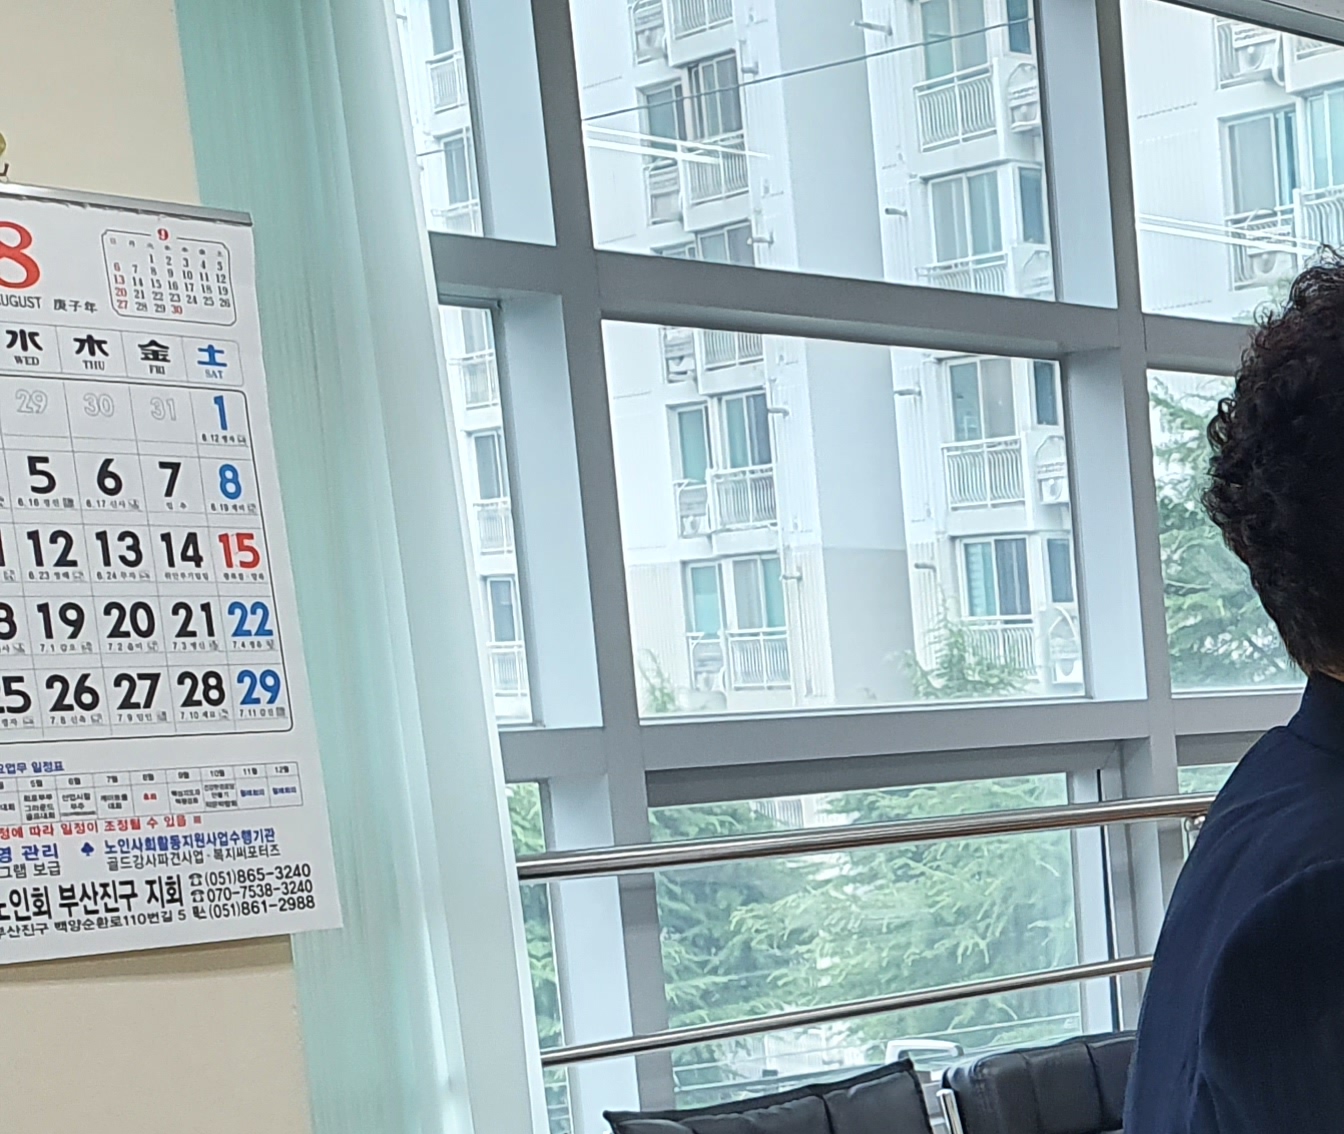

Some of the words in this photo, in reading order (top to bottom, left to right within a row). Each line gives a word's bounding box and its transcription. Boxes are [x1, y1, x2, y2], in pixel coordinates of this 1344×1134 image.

[157, 228, 169, 241] 9
[0, 221, 41, 289] 8
[149, 254, 154, 264] 1
[166, 256, 172, 266] 2
[183, 257, 189, 268] 3
[201, 260, 206, 269] 4
[217, 261, 223, 271] 5
[114, 262, 121, 272] 6
[132, 264, 138, 274] 7
[150, 267, 157, 276] 8
[167, 268, 173, 278] 9
[182, 270, 193, 280] 10
[200, 272, 209, 282] 11
[216, 273, 226, 284] 12
[114, 274, 125, 285] 13
[132, 276, 143, 287] 14
[151, 278, 162, 288] 15
[168, 280, 178, 291] 16
[185, 282, 194, 292] 17
[201, 284, 212, 294] 18
[218, 285, 228, 296] 19
[0, 294, 41, 309] UGUST
[54, 299, 97, 313] 庚子年
[115, 287, 127, 297] 20
[134, 289, 145, 300] 21
[152, 291, 163, 301] 22
[169, 293, 181, 303] 23
[186, 294, 197, 305] 24
[203, 296, 214, 307] 25
[219, 297, 231, 308] 26
[117, 299, 128, 310] 27
[135, 301, 147, 312] 28
[154, 303, 166, 314] 29
[171, 304, 183, 315] 30
[5, 329, 43, 352] 水
[73, 334, 109, 357] 木
[138, 340, 171, 363] 金
[197, 344, 228, 367] 土
[14, 356, 40, 366] WED
[82, 360, 105, 371] THU
[149, 365, 166, 375] FRI
[205, 369, 224, 379] SAT
[15, 389, 48, 414] 29
[83, 393, 115, 417] 30
[151, 397, 177, 421] 31
[213, 395, 228, 430] 1
[27, 456, 56, 494] 5
[97, 458, 123, 496] 6
[158, 462, 182, 497] 7
[218, 463, 242, 500] 8
[27, 530, 78, 567] 12
[95, 530, 143, 568] 13
[160, 532, 204, 568] 14
[218, 533, 260, 568] 15
[37, 602, 85, 640] 19
[103, 602, 155, 638] 20
[171, 602, 215, 638] 21
[227, 601, 274, 637] 22
[0, 676, 31, 714] 5
[45, 674, 100, 712] 26
[113, 673, 161, 710] 27
[177, 671, 225, 708] 28
[237, 669, 281, 705] 29
[31, 761, 64, 773] 일정표
[29, 823, 54, 837] 따라
[60, 820, 98, 836] 일정이
[147, 818, 158, 829] 수
[21, 843, 59, 861] 관리
[33, 860, 61, 876] 보급
[205, 863, 311, 887] (051)865-3240
[58, 879, 138, 918] 부산진구
[145, 873, 184, 909] 지회
[207, 879, 313, 903] 070-7538-3240
[178, 909, 186, 920] 5
[209, 895, 316, 920] (051)861-2988
